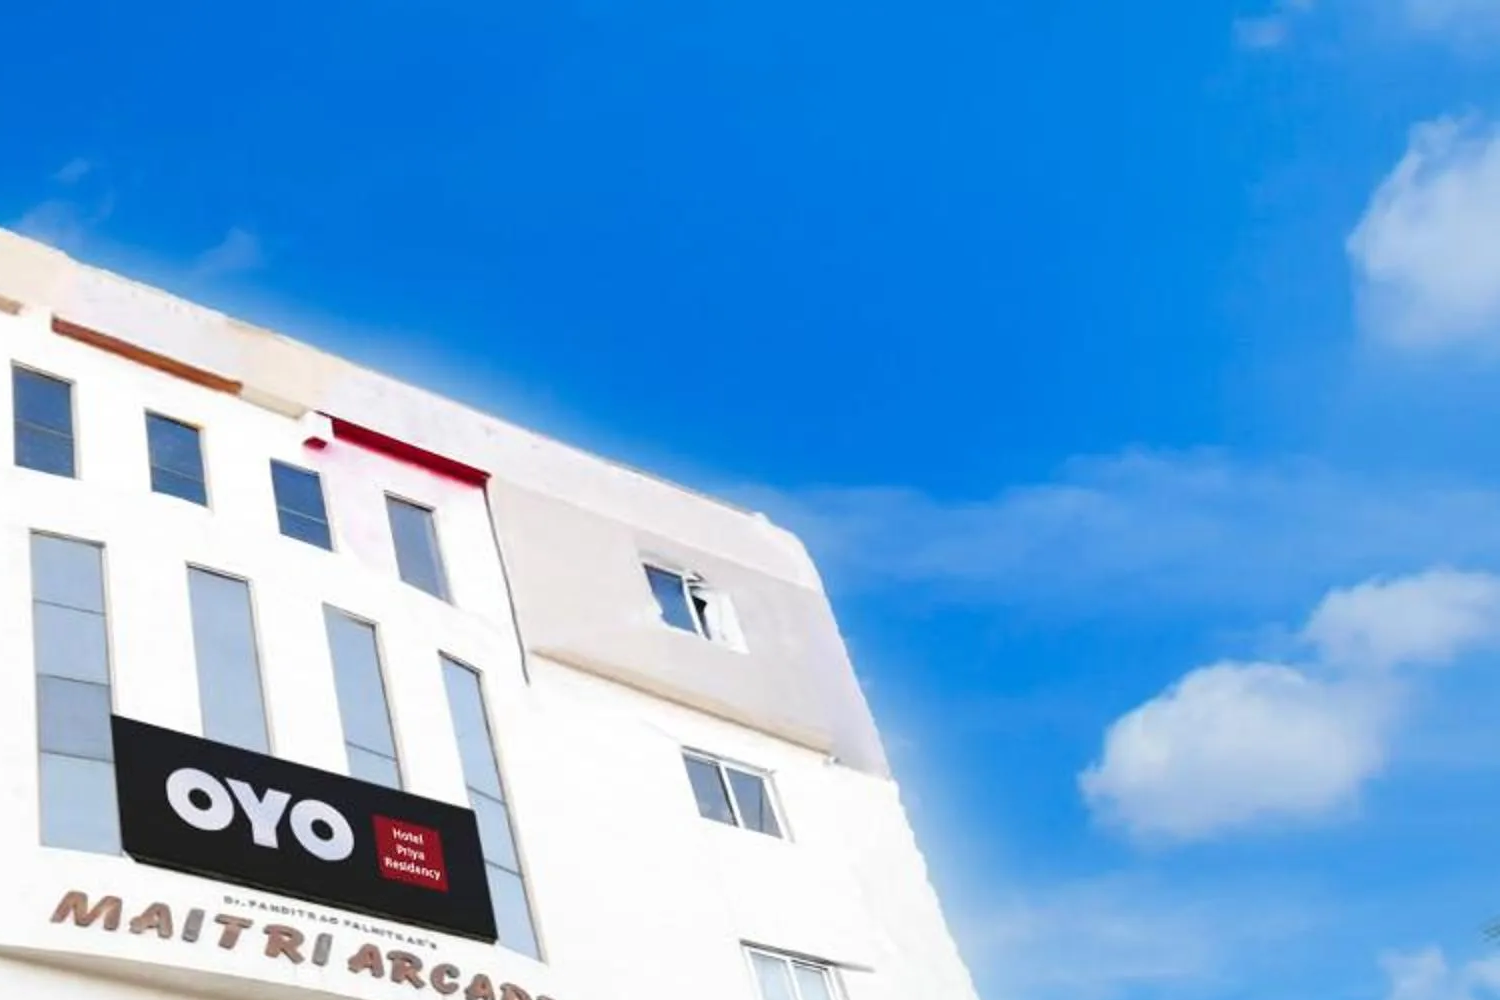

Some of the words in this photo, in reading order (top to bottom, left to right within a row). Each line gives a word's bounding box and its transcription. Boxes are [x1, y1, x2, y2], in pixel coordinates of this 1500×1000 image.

[166, 767, 355, 861] OYO
[392, 826, 424, 845] Hotel
[396, 844, 425, 861] Priya
[384, 857, 441, 881] Residency
[50, 890, 333, 967] MAITRI
